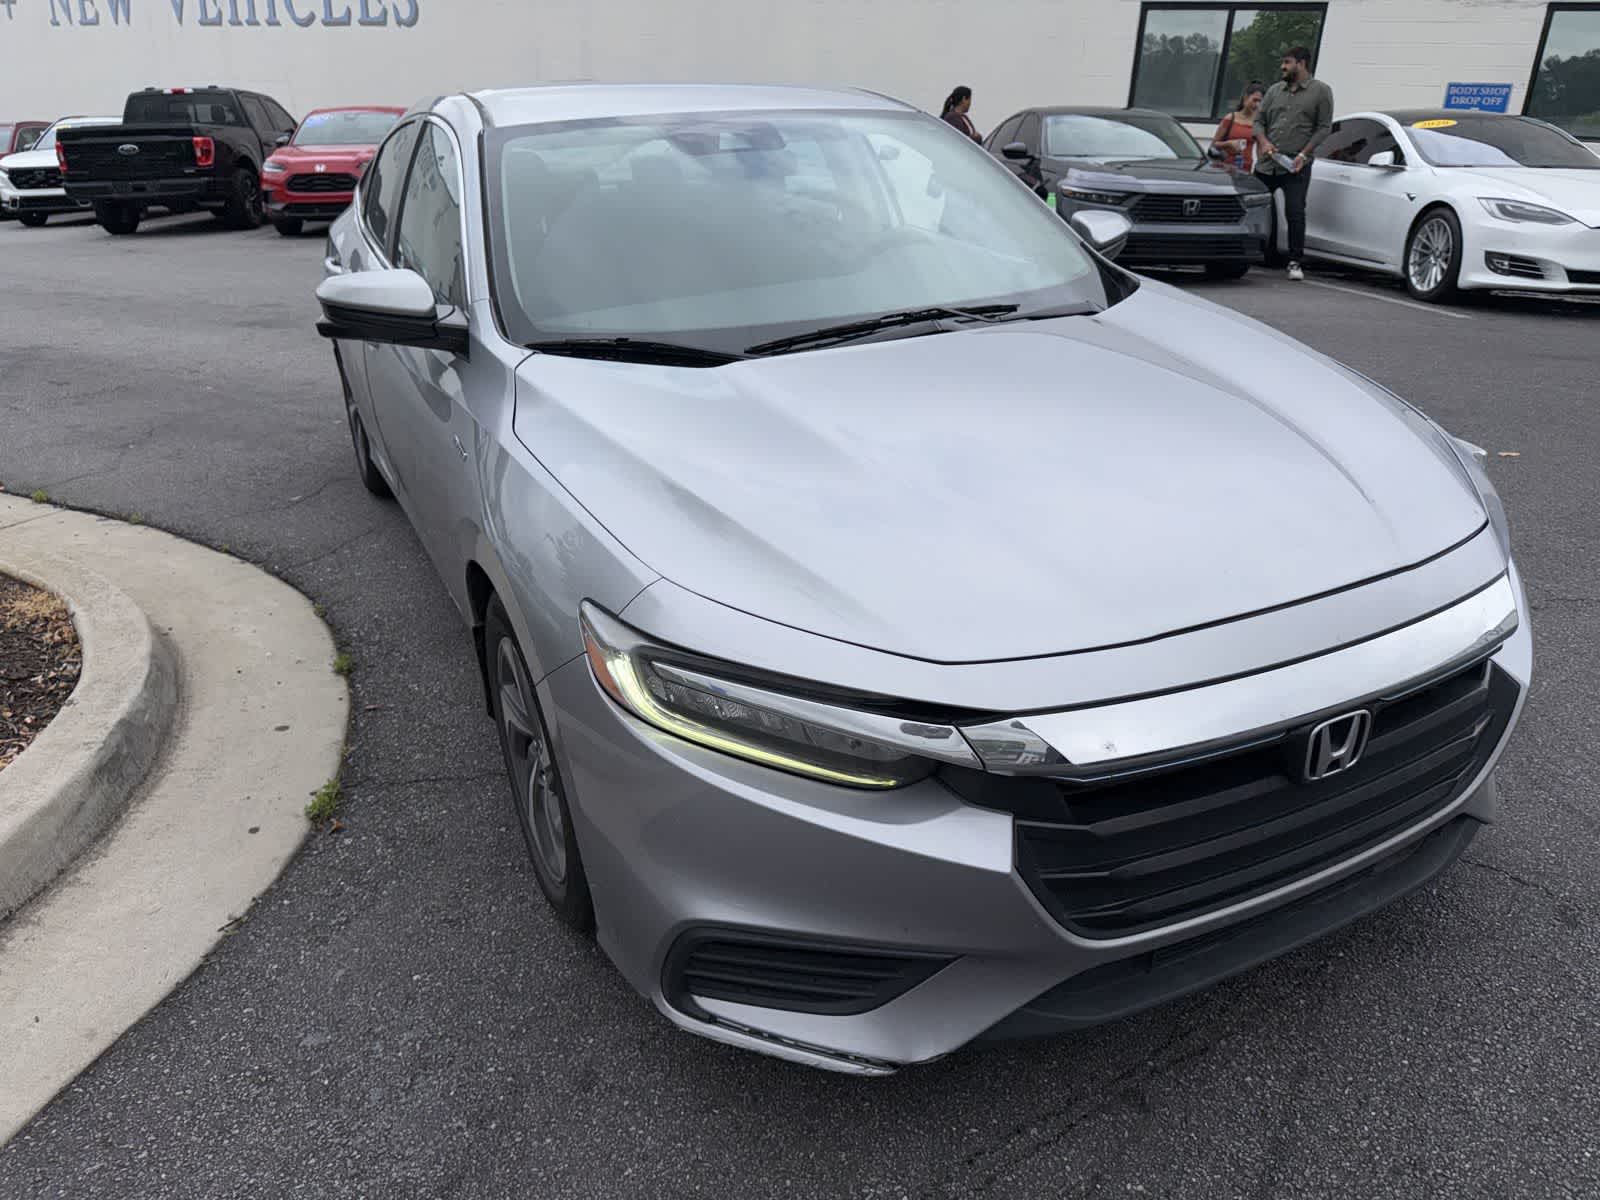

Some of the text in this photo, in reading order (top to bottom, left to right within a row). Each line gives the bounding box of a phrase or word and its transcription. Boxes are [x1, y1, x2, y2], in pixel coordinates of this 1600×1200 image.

[49, 0, 130, 26] NEW
[169, 0, 419, 27] VEHICLES
[1449, 86, 1510, 96] BODY SHOP
[1450, 96, 1504, 106] DROP OFF
